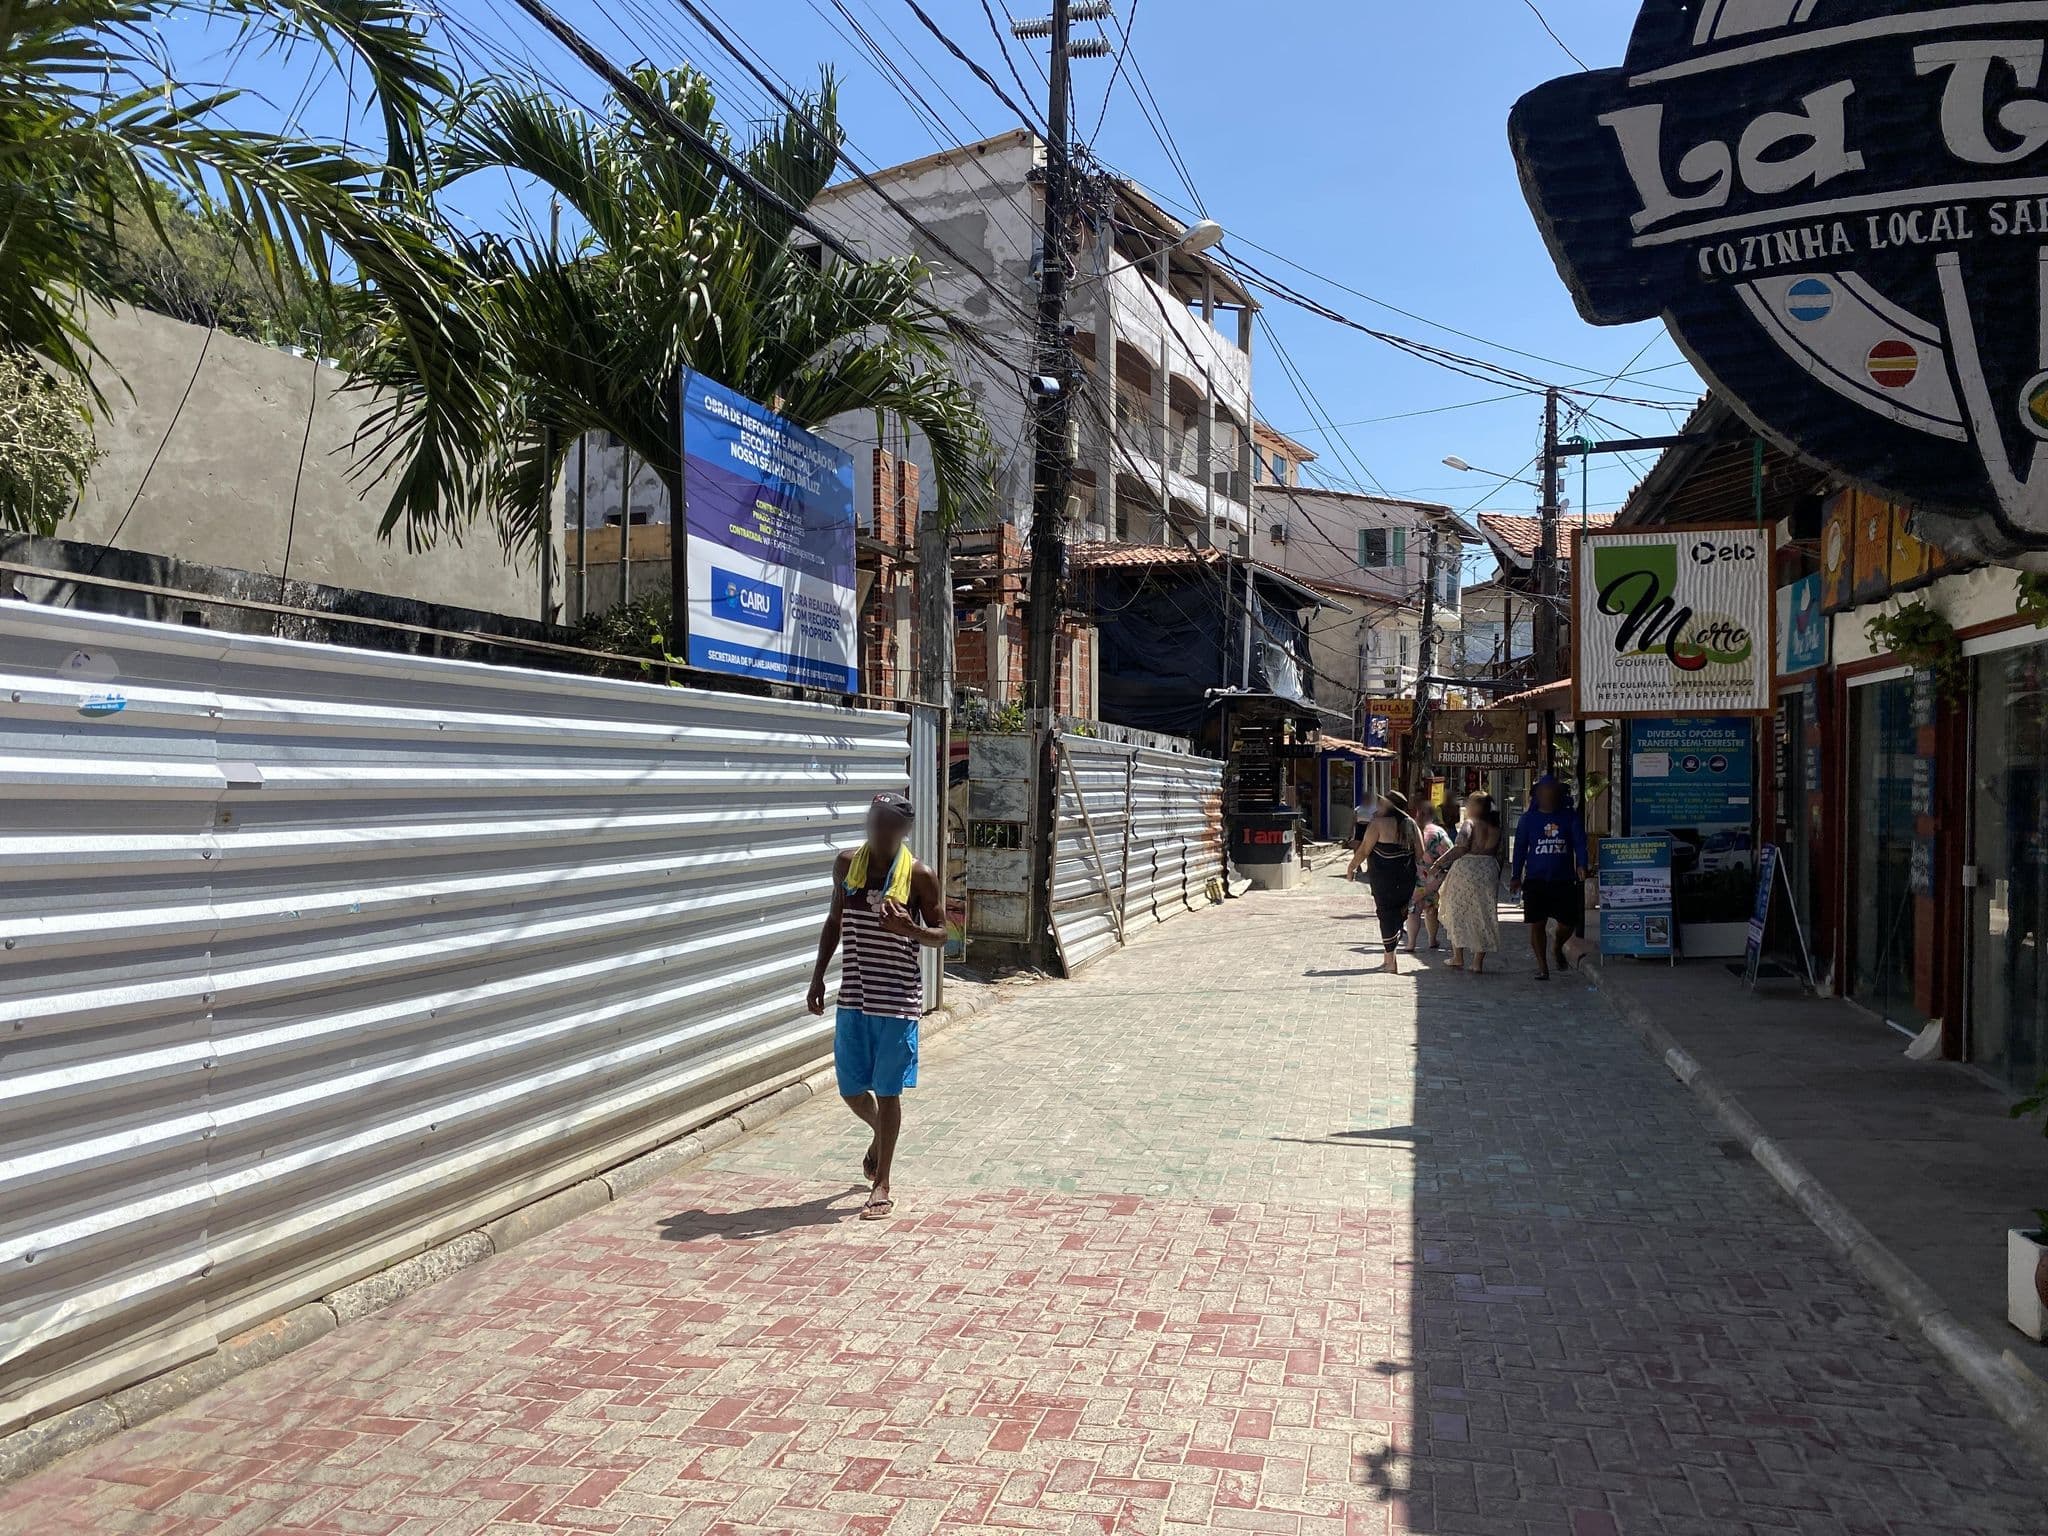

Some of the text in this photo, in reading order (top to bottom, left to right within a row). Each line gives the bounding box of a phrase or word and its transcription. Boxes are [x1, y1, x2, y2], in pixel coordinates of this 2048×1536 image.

[1597, 79, 1865, 233] La
[1697, 220, 1855, 277] COZINHA
[1867, 205, 1973, 250] LOCAL
[704, 395, 729, 421] OBRA
[729, 407, 742, 426] DE
[742, 414, 780, 445] REFORMA
[741, 430, 810, 475] ESCOLA MUNICIPAL
[730, 442, 759, 469] NOSSA
[807, 476, 821, 496] LUZ
[740, 588, 770, 612] CAIRU
[789, 592, 842, 618] OBRA REALIZADA
[791, 607, 840, 631] COM RECURSOS
[708, 649, 741, 665] SECRETARIA
[748, 657, 788, 673] PLANEJAMENTO
[1614, 657, 1669, 668] GOURMET
[1598, 691, 1679, 700] RESTAURANTE
[1637, 739, 1681, 747] TRANSFER
[1646, 729, 1687, 738] DIVERSAS
[1725, 729, 1737, 738] DE
[1438, 752, 1520, 764] FRIGIDEIRA DE BARRO
[1443, 742, 1516, 753] RESTAURANTE
